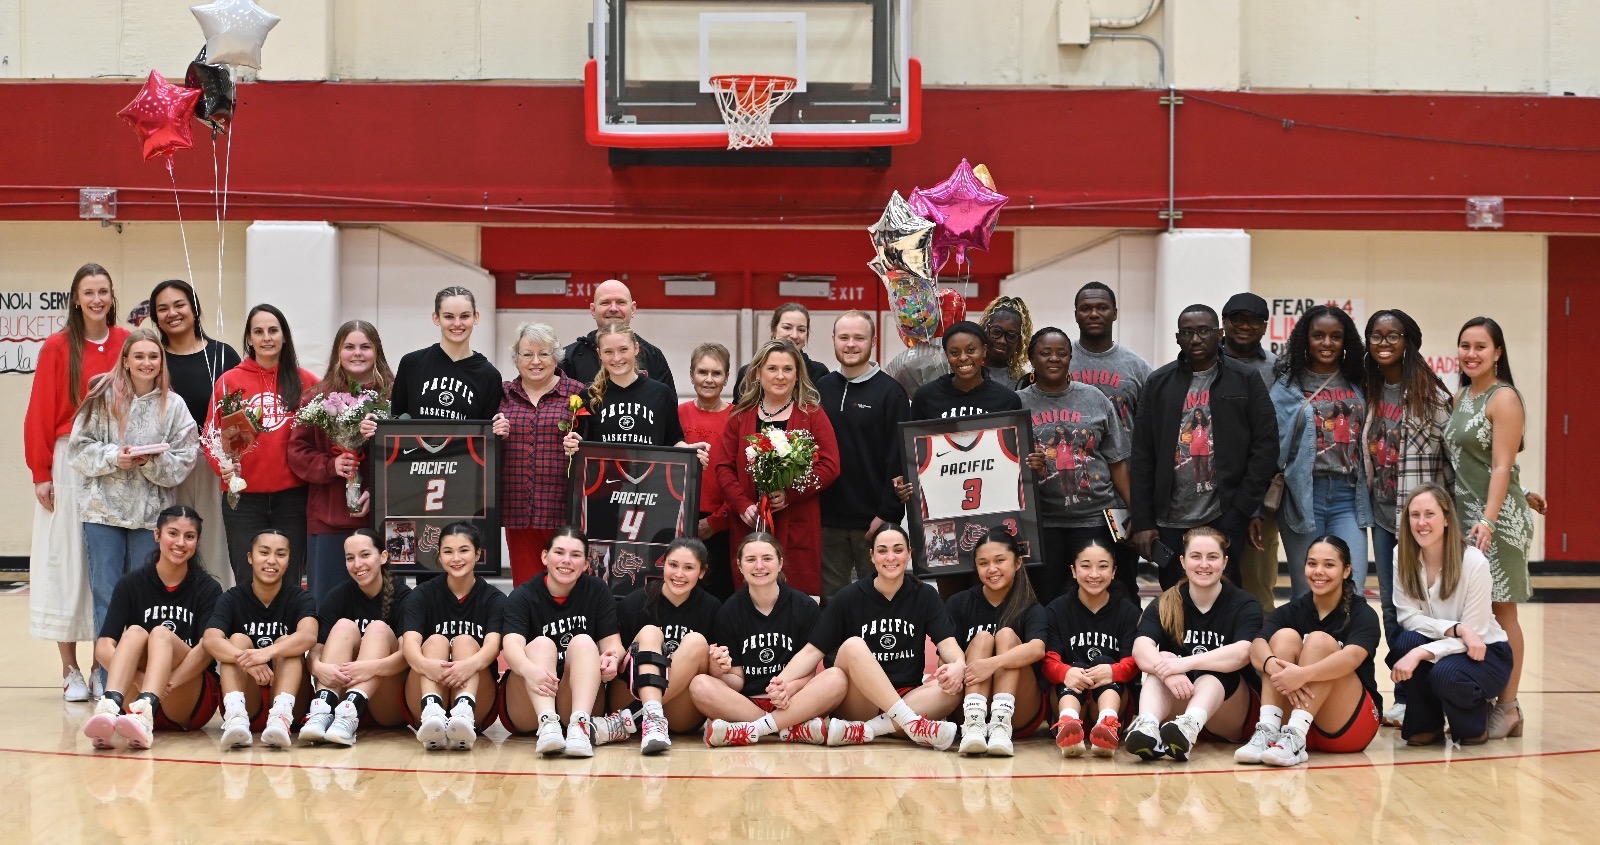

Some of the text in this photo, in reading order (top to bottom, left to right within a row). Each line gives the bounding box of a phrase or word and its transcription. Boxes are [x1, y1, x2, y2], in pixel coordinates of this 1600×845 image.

[0, 292, 31, 310] NOW
[829, 287, 864, 300] EXIT
[421, 377, 474, 405] PACIFIC
[600, 402, 654, 425] PACIFIC
[601, 433, 653, 445] BASKETBALL
[410, 461, 458, 475] PACIFIC
[940, 458, 995, 477] PACIFIC
[425, 478, 446, 512] 2
[610, 491, 658, 506] PACIFIC
[961, 477, 983, 511] 3
[620, 509, 646, 542] 4
[1002, 518, 1018, 537] 3
[435, 620, 484, 639] PACIFIC
[861, 618, 915, 639] PACIFIC
[742, 632, 793, 655] PACIFIC
[1070, 631, 1120, 652] PACIFIC
